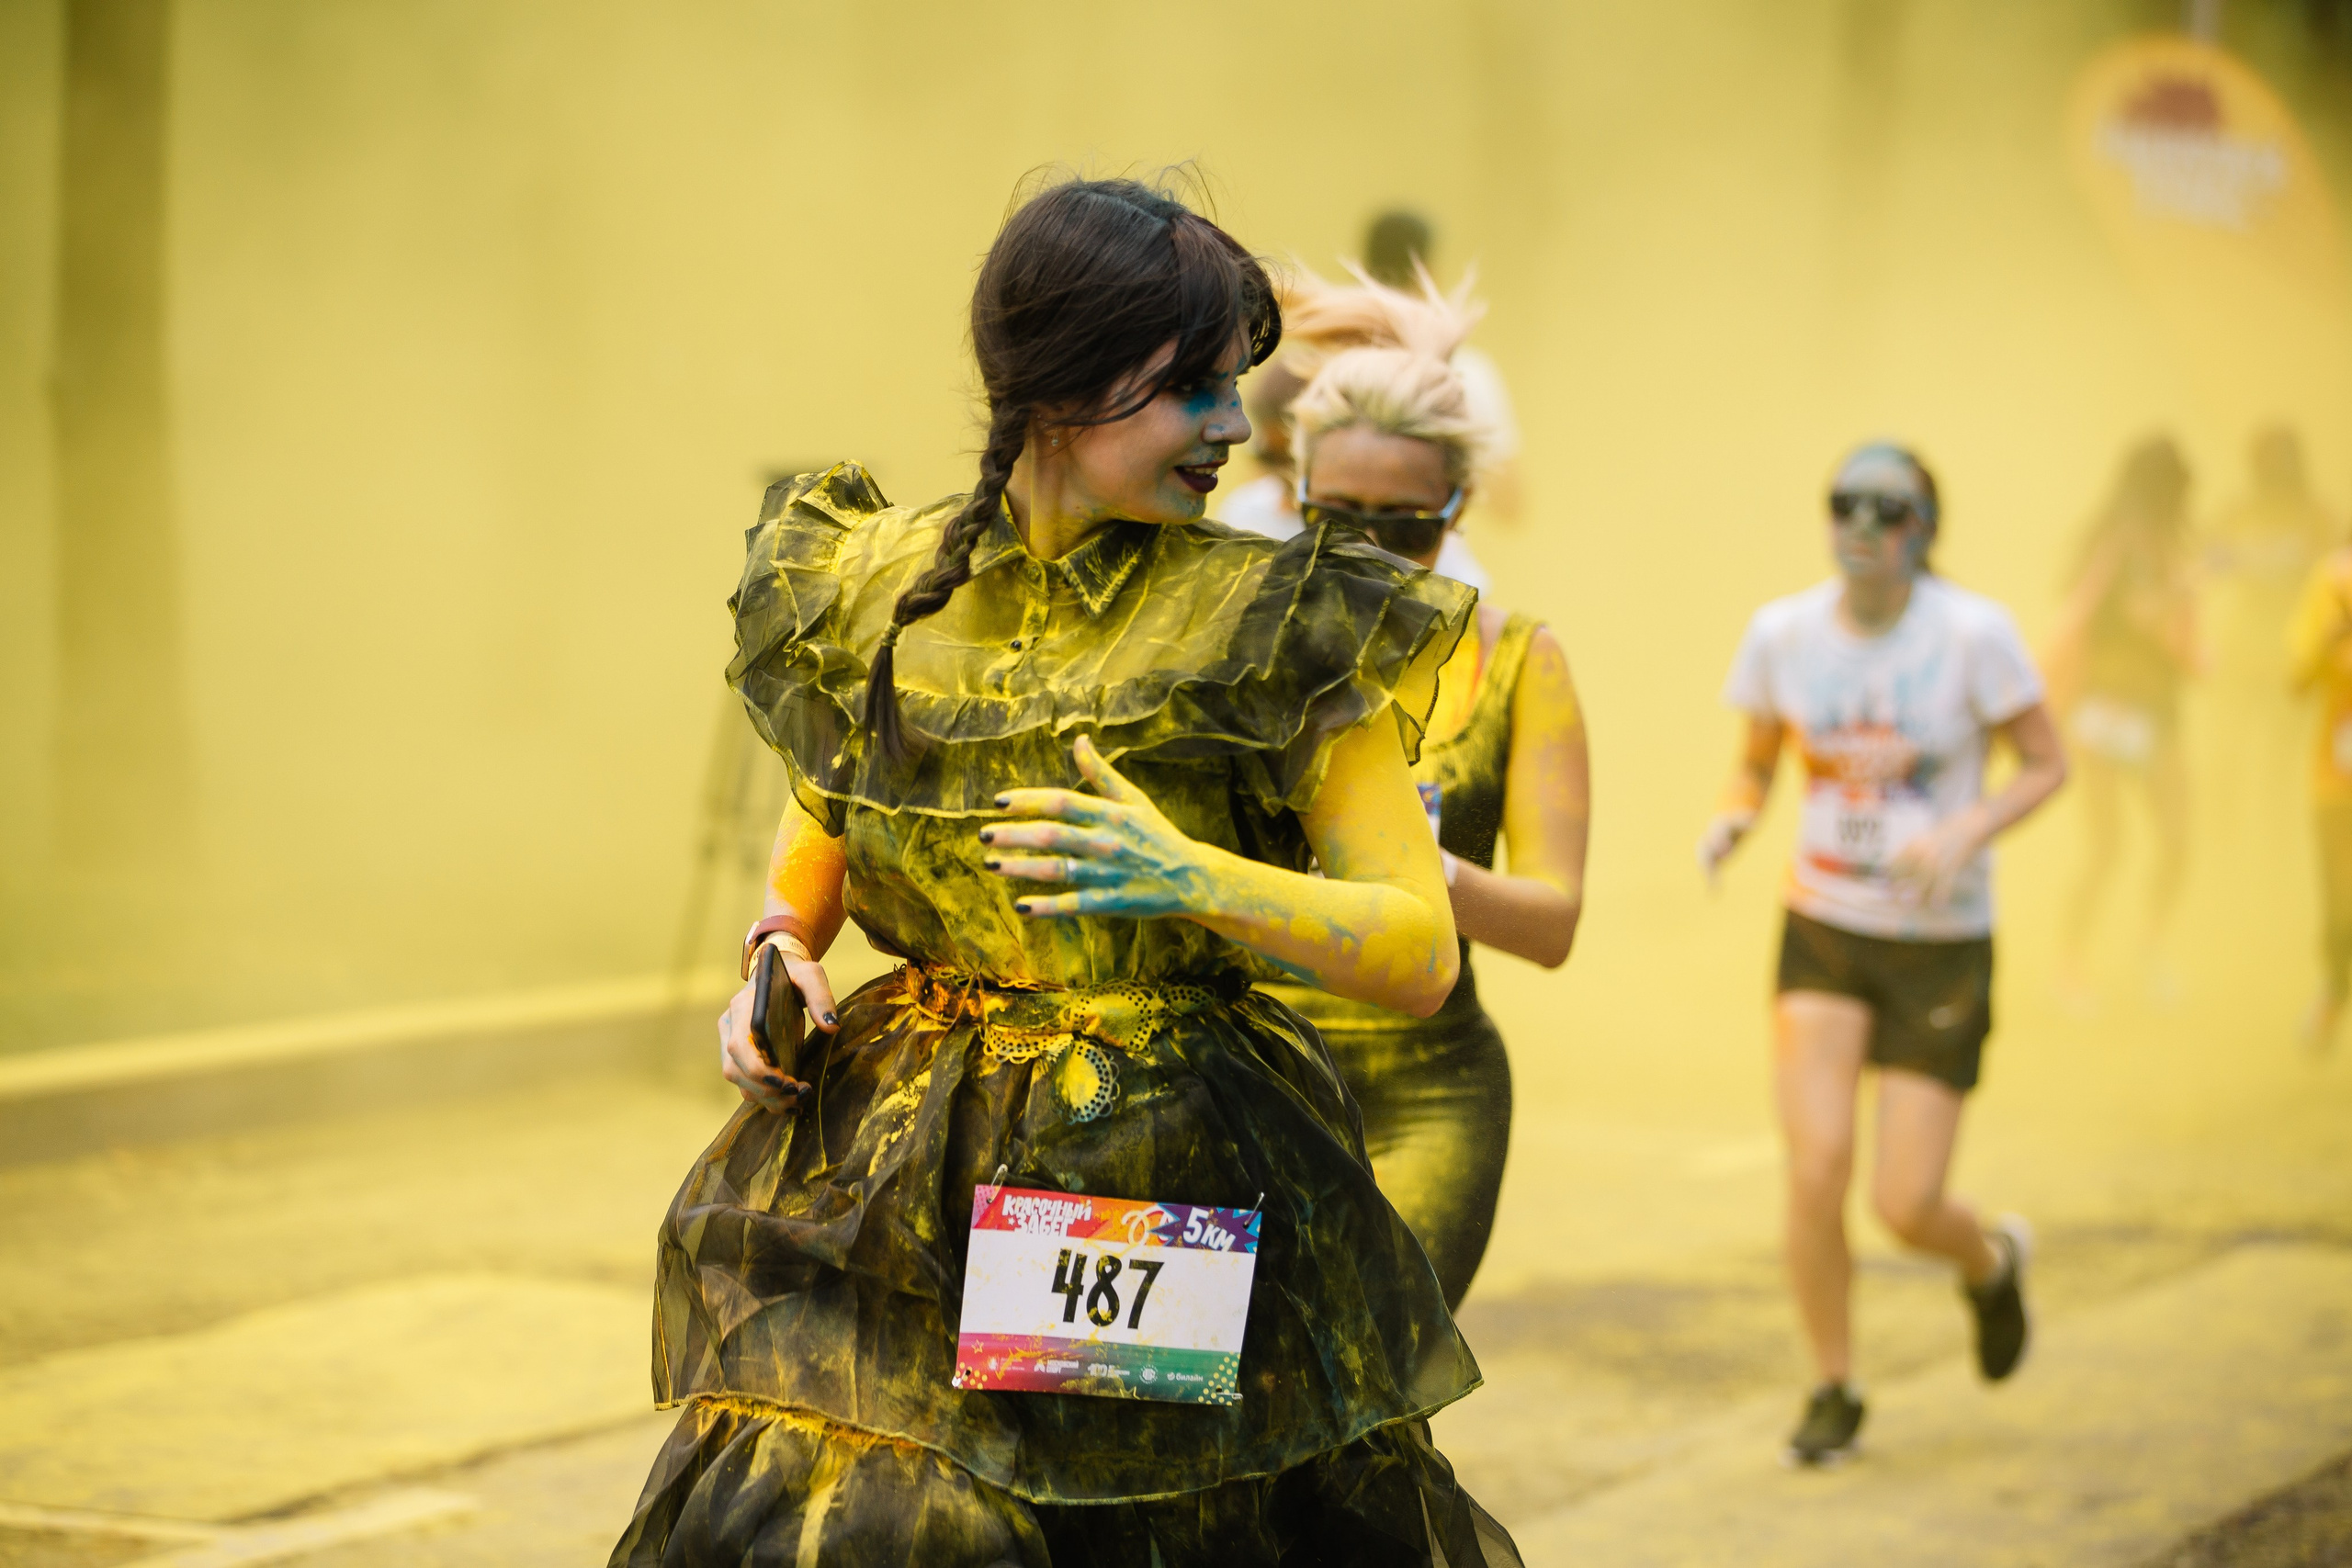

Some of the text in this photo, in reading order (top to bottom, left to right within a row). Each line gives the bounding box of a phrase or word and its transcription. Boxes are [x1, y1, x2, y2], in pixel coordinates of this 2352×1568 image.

[1001, 1194, 1092, 1222] КРАСОЧНЫЙ
[1013, 1213, 1076, 1237] ЗАБЕГ
[1051, 1248, 1165, 1329] 487
